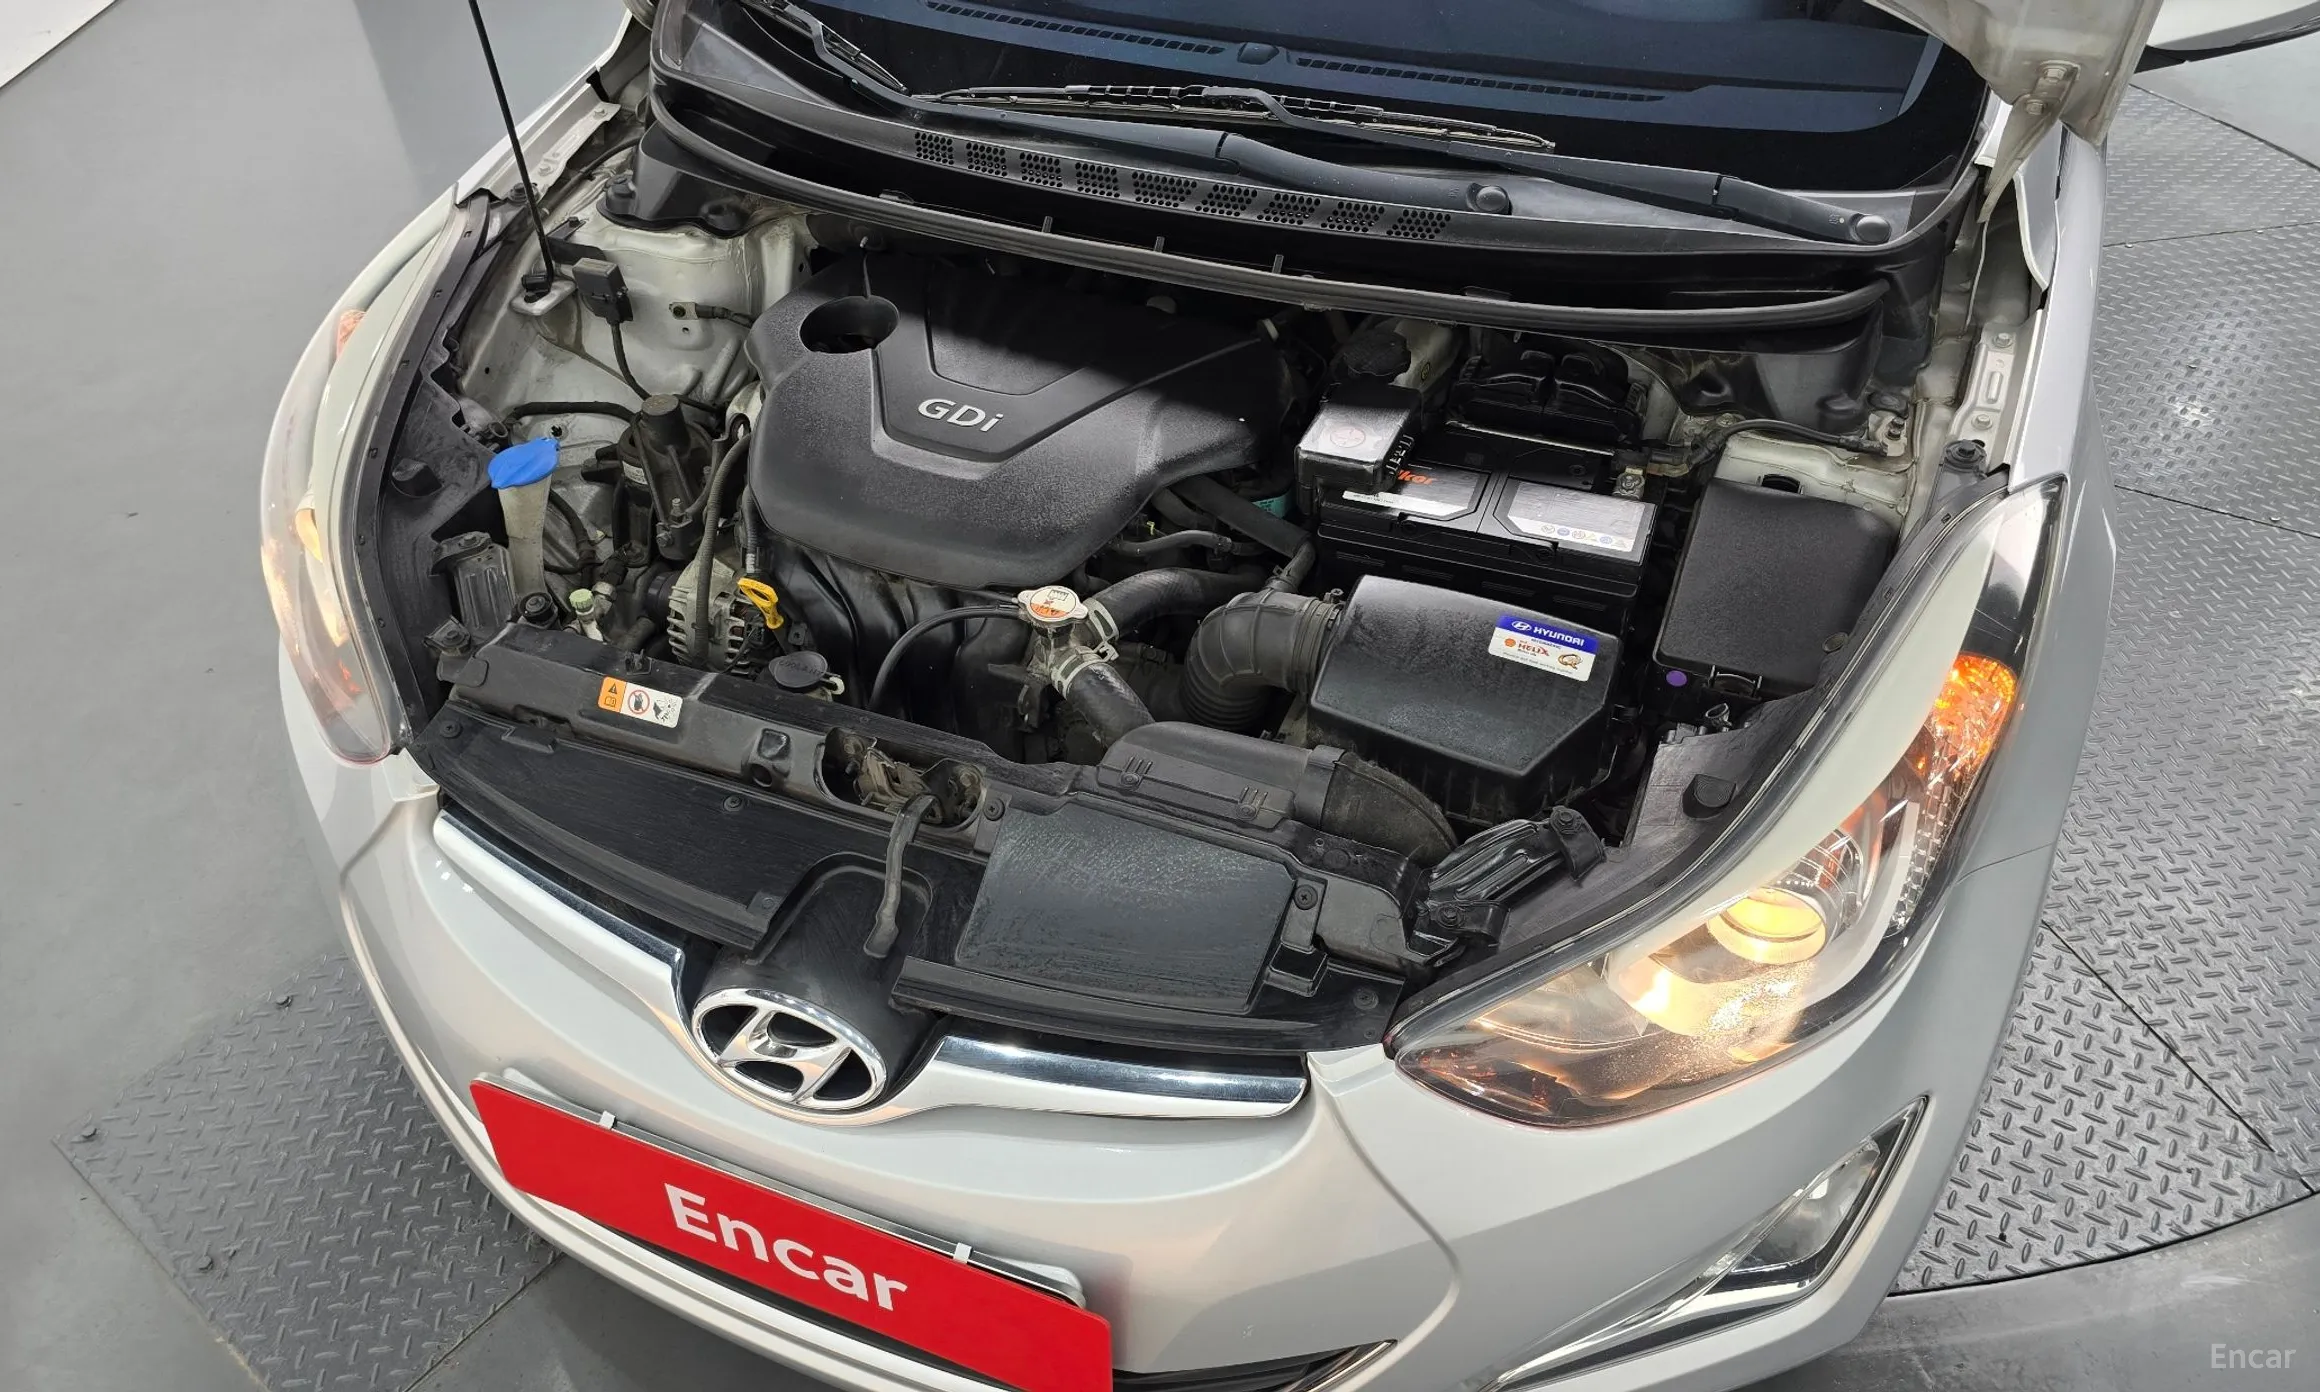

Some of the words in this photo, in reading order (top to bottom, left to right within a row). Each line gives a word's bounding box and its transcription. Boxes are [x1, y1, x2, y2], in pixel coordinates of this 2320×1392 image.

[918, 398, 1004, 432] GDi
[1533, 626, 1585, 647] HYUNDAI
[664, 1182, 908, 1311] Encar
